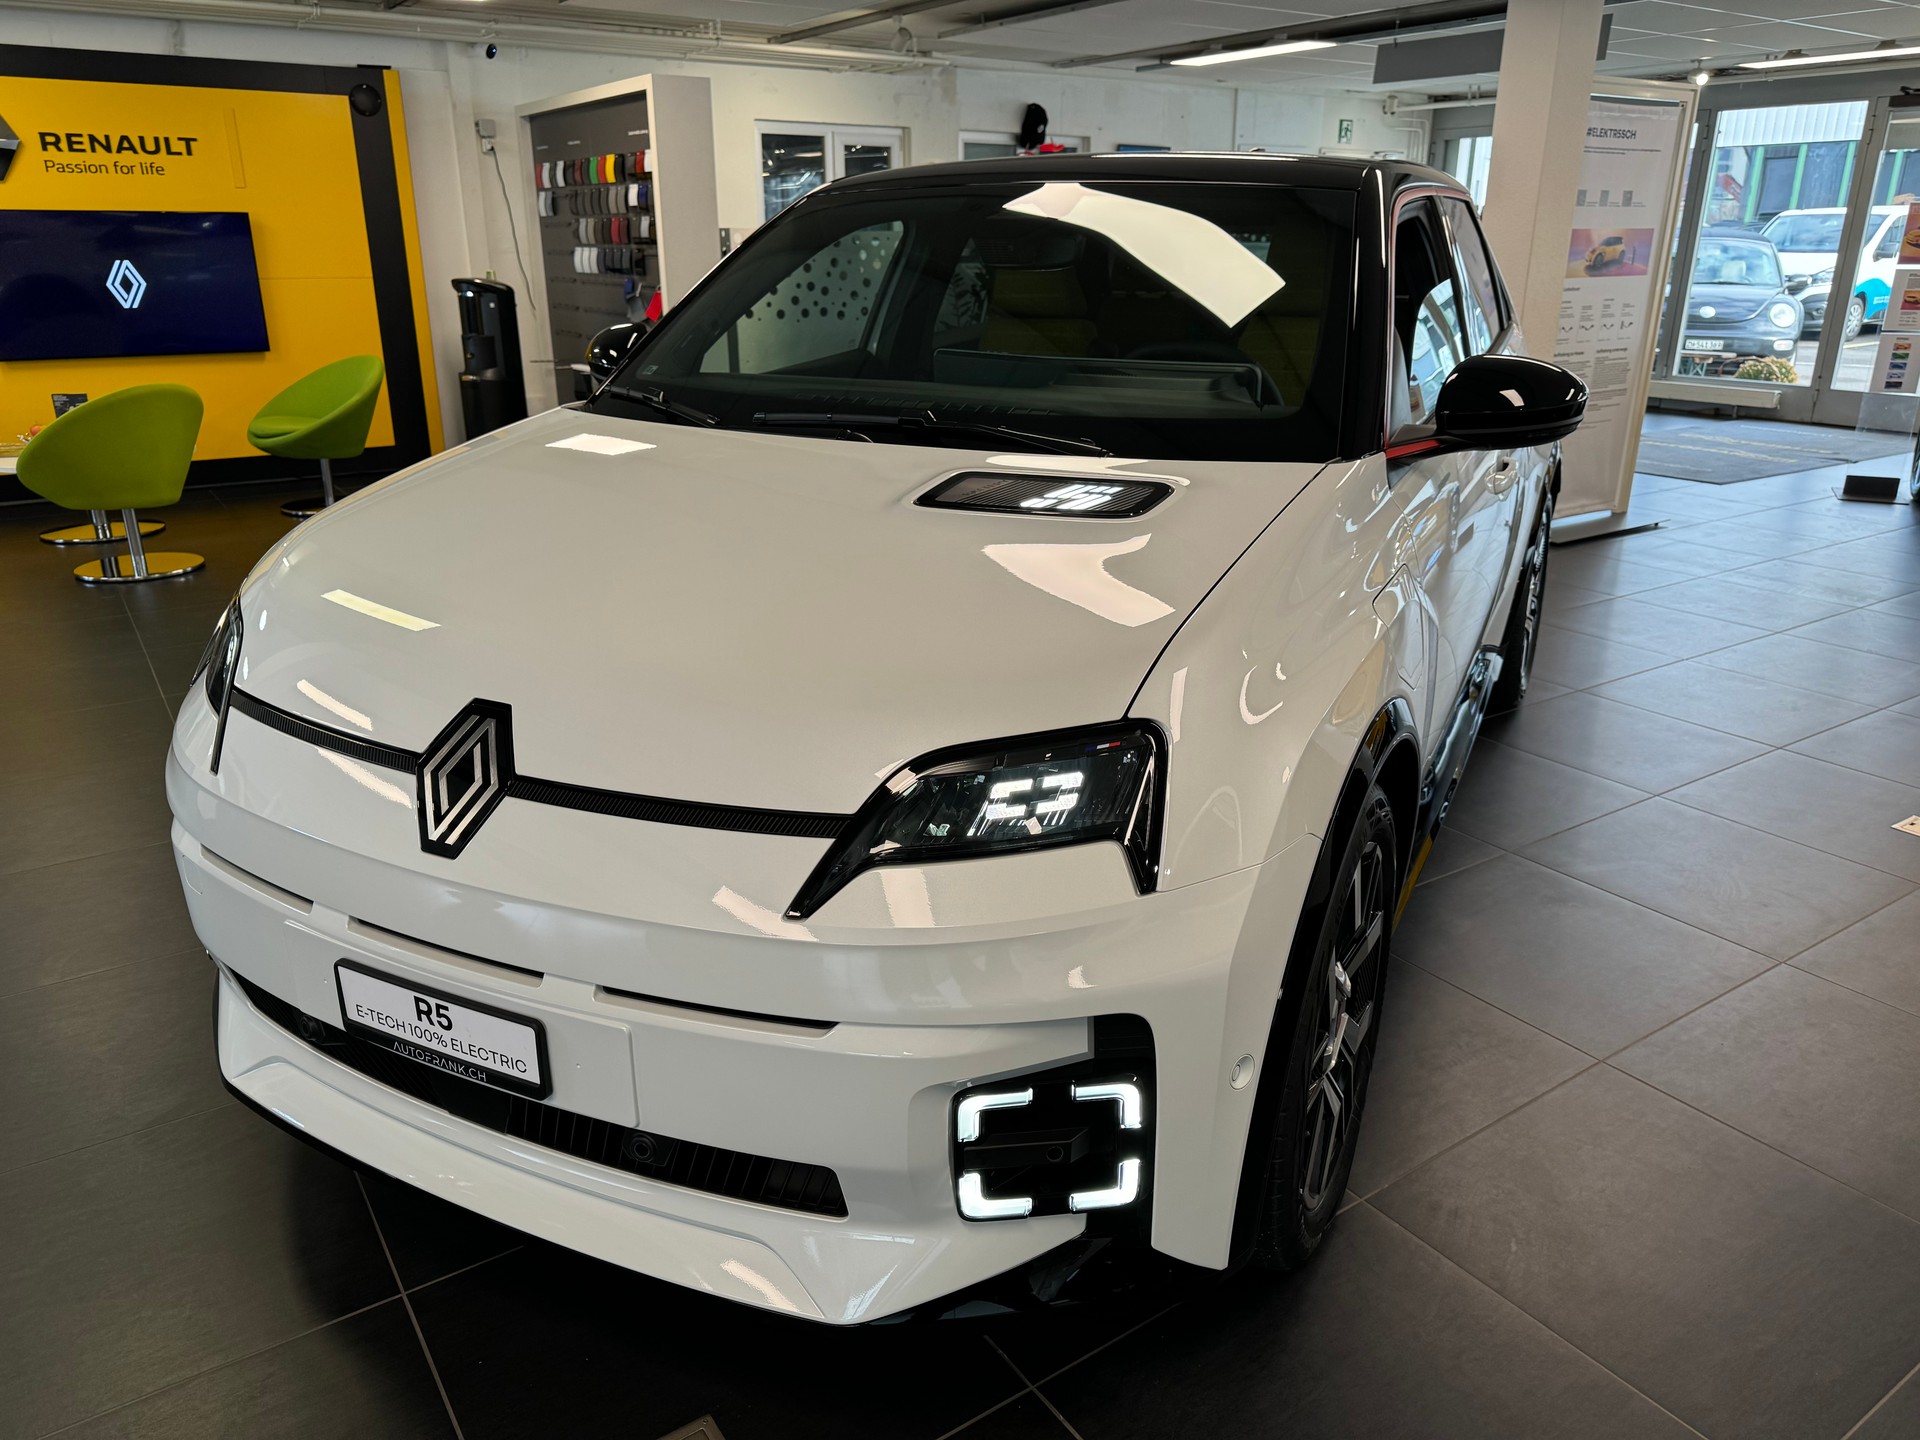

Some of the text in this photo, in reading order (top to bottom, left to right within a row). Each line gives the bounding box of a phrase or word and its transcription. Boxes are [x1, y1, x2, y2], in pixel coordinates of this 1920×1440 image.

[38, 131, 198, 156] RENAULT
[44, 159, 166, 176] Passion for life
[413, 995, 453, 1031] R5
[356, 1003, 528, 1074] E-TECH 100% ELECTRIC
[393, 1041, 487, 1082] AUTOFRANK.CH
